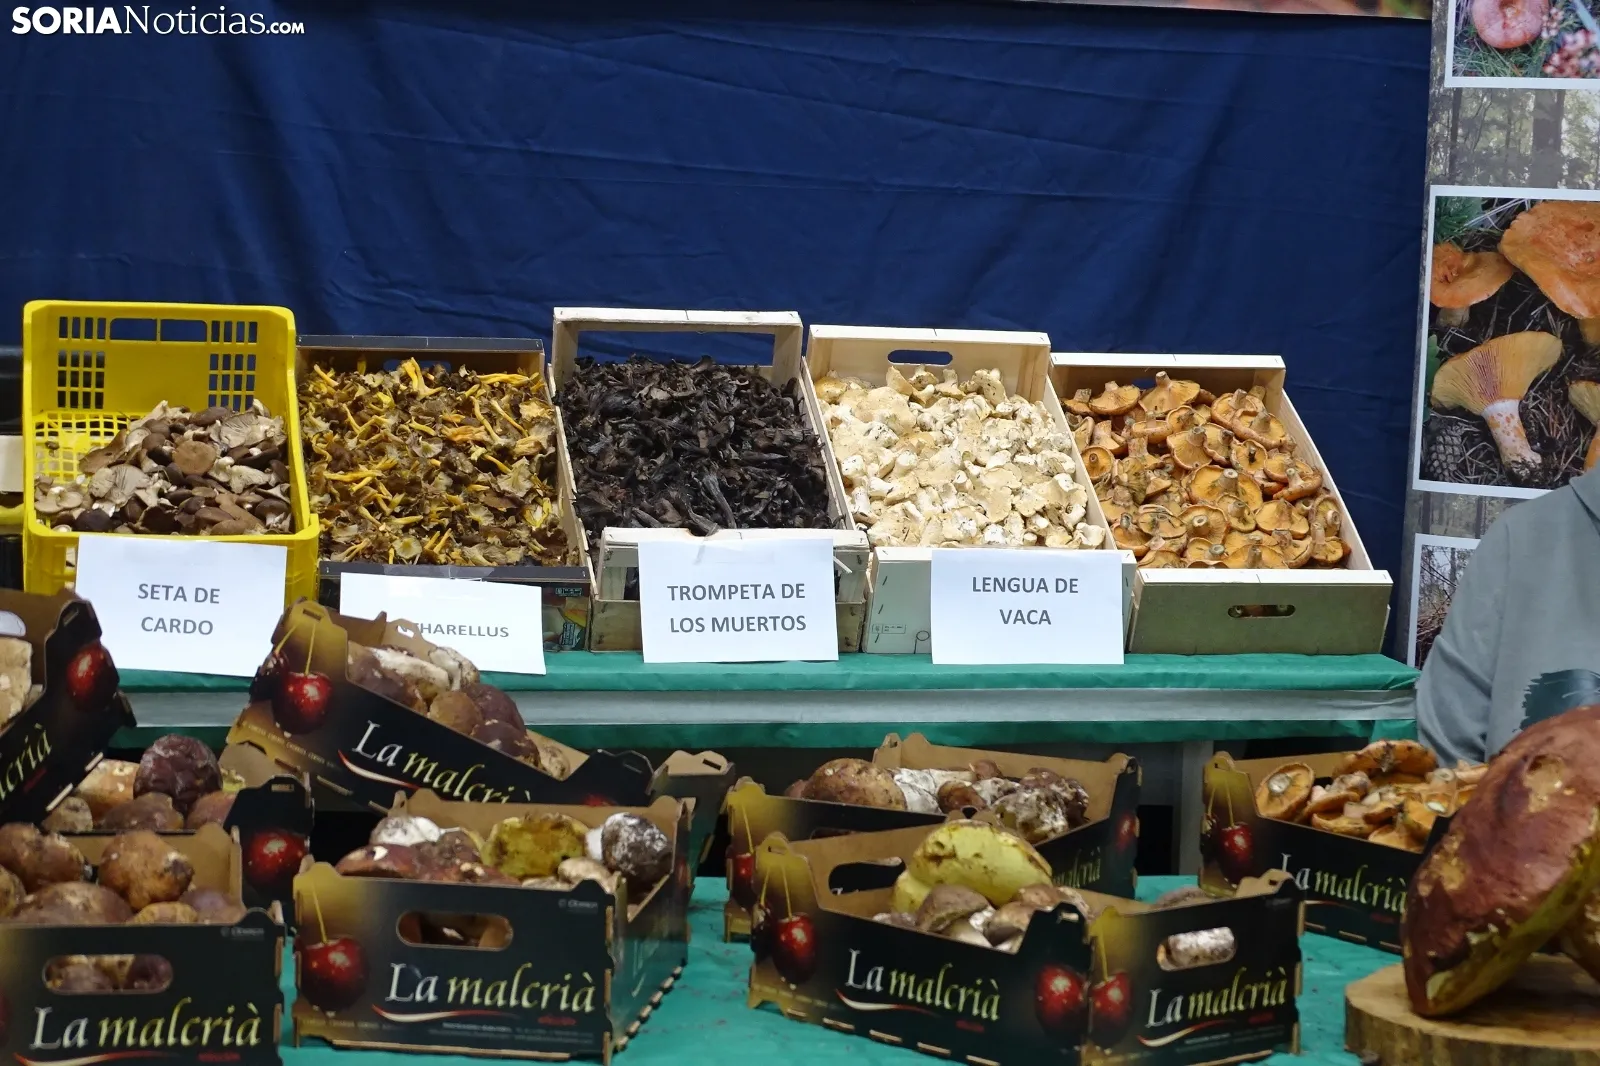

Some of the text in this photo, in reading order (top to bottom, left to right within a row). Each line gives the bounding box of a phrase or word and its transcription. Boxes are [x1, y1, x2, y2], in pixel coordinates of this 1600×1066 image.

[138, 583, 220, 604] SETA DE
[667, 583, 806, 600] TROMPETA DE
[972, 576, 1079, 593] LENGUA DE
[141, 616, 213, 635] CARDO
[670, 615, 806, 632] LOS MUERTOS
[999, 608, 1051, 625] VACA
[352, 720, 403, 767] La
[384, 962, 596, 1013] La malcrià
[845, 948, 884, 992] La
[889, 962, 1000, 1021] malcrià
[1145, 966, 1288, 1028] La malcrià
[29, 997, 262, 1050] La malcrià
